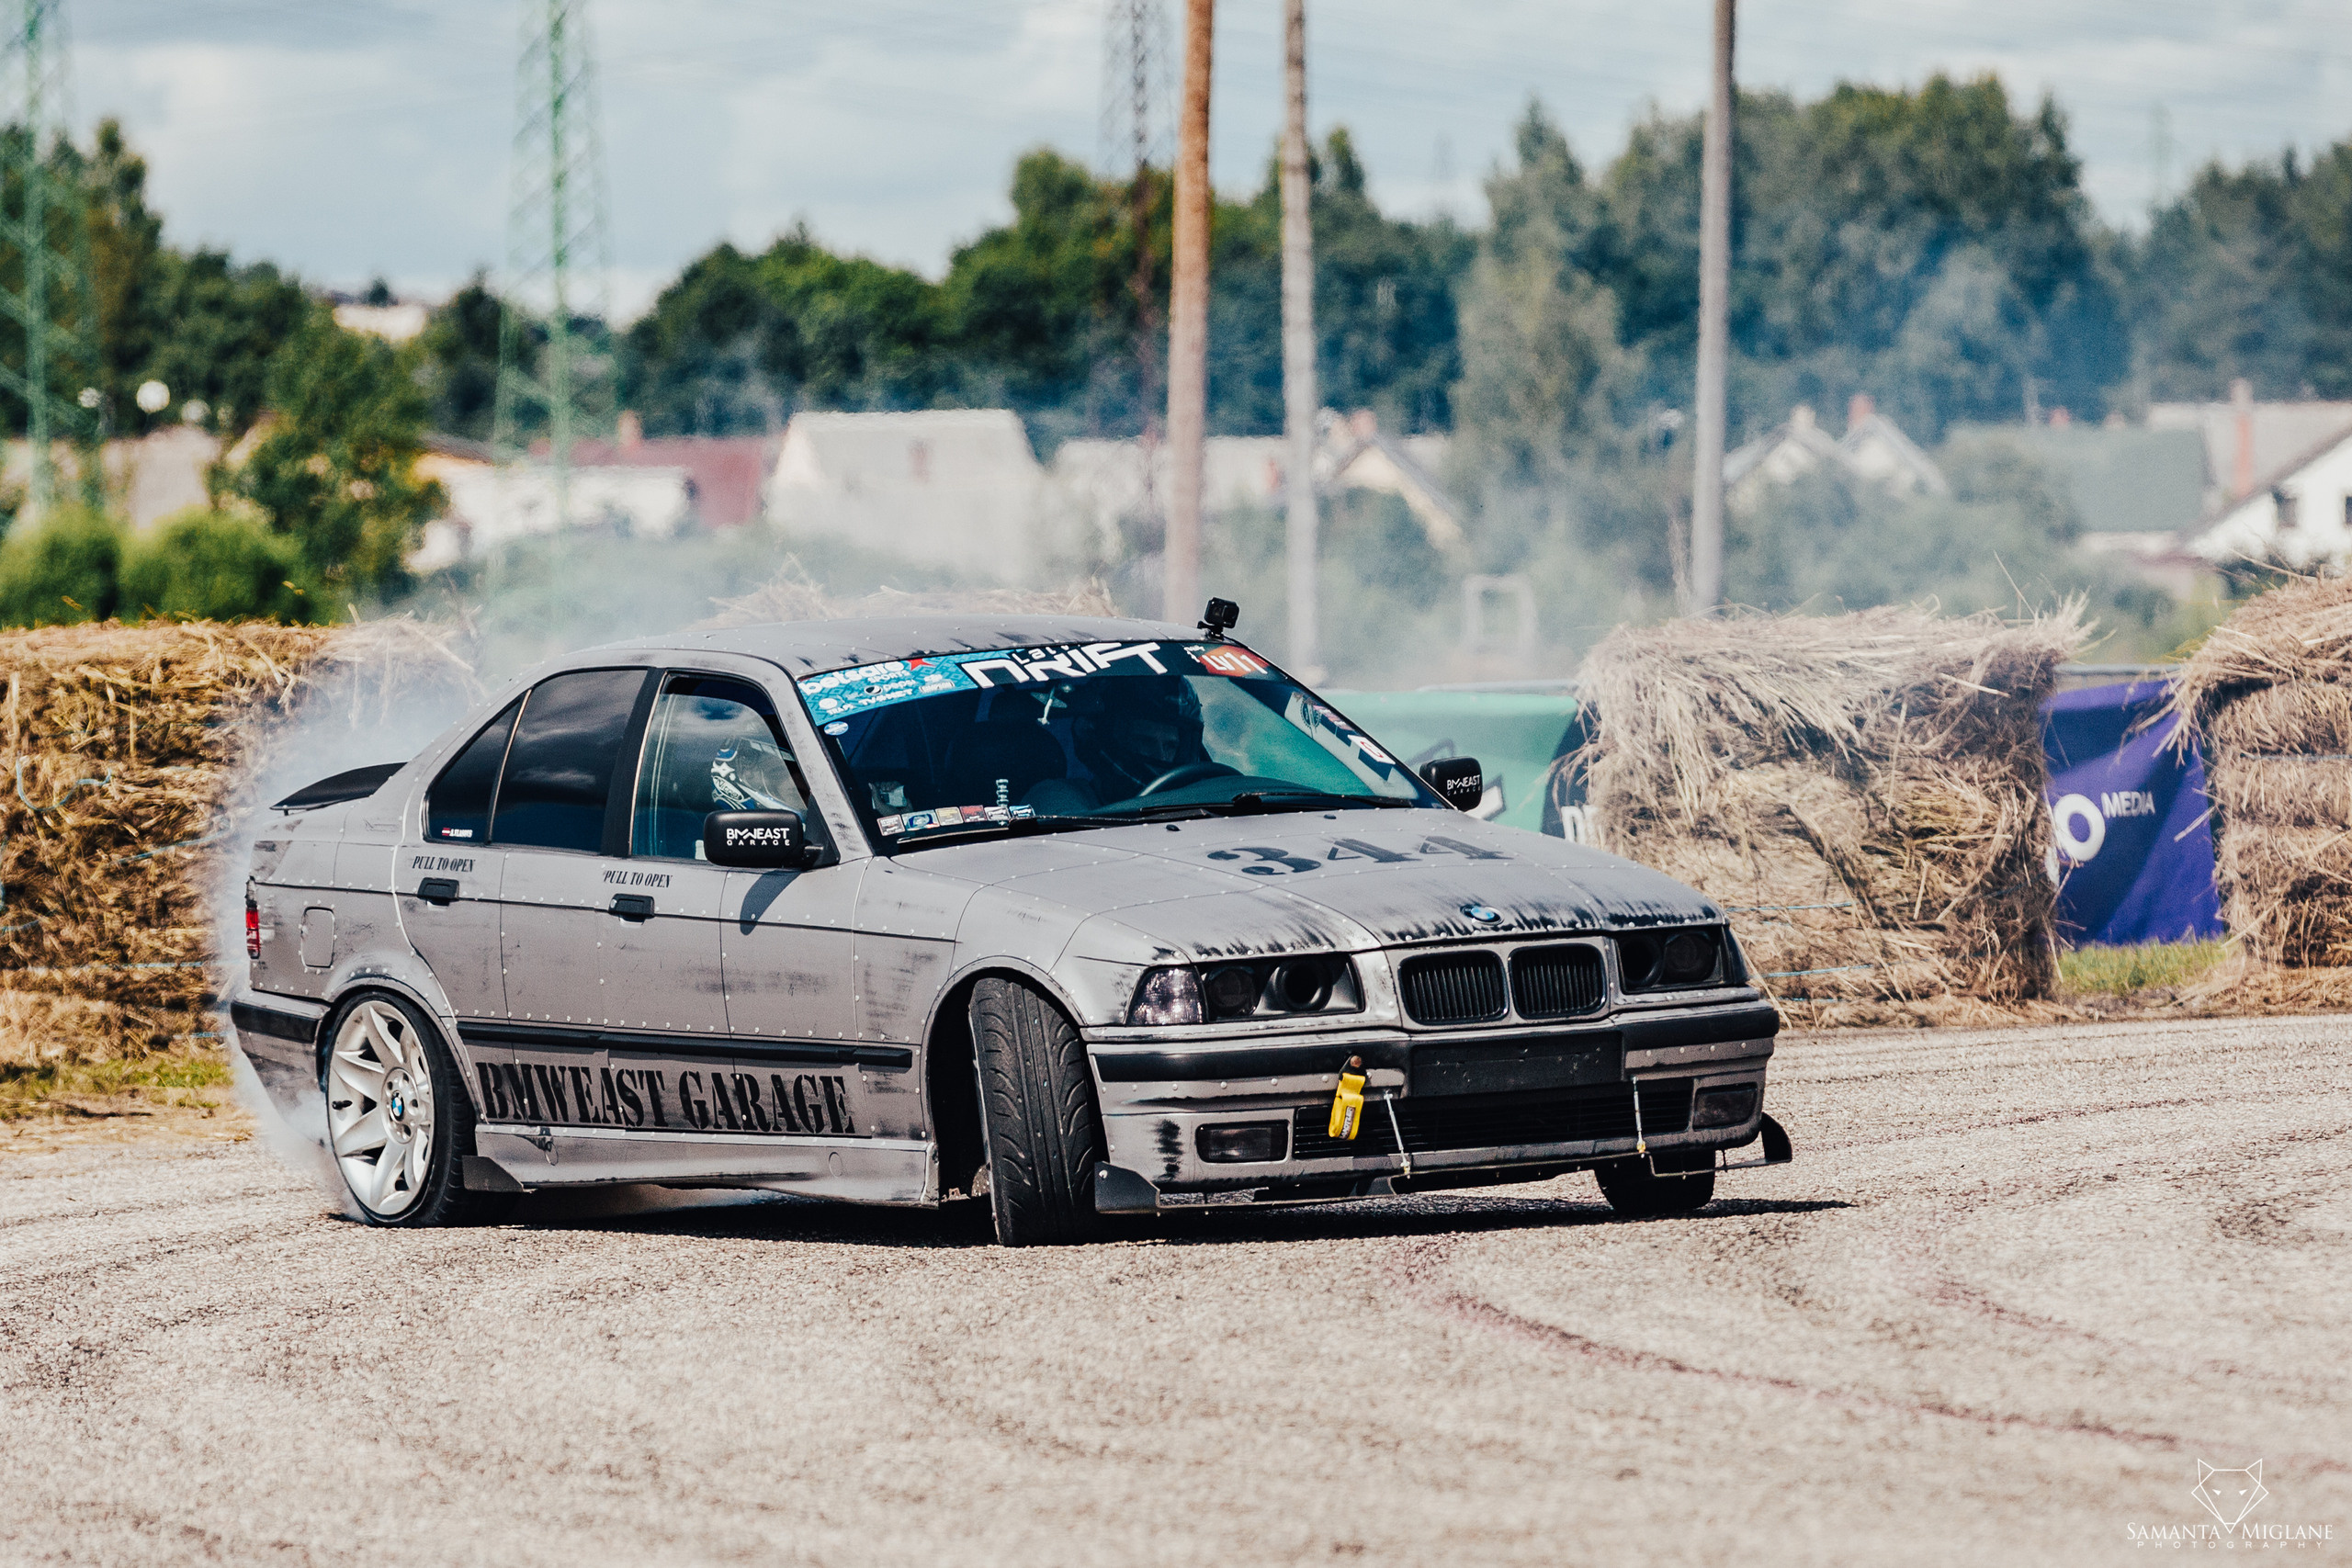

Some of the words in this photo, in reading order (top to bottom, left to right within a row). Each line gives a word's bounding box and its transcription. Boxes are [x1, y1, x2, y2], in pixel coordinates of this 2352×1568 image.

[961, 642, 1169, 689] DRIFT
[1446, 774, 1481, 791] BMWEAST
[2100, 791, 2156, 818] MEDIA
[726, 828, 790, 840] BMWEAST
[413, 855, 435, 870] PULL
[435, 857, 449, 871] TO
[449, 858, 476, 873] OPEN
[1207, 835, 1514, 875] 344
[603, 870, 628, 885] PULL
[629, 872, 644, 886] TO
[644, 873, 673, 888] OPEN
[475, 1062, 669, 1128] BMWEAST
[679, 1070, 855, 1134] GARAGE
